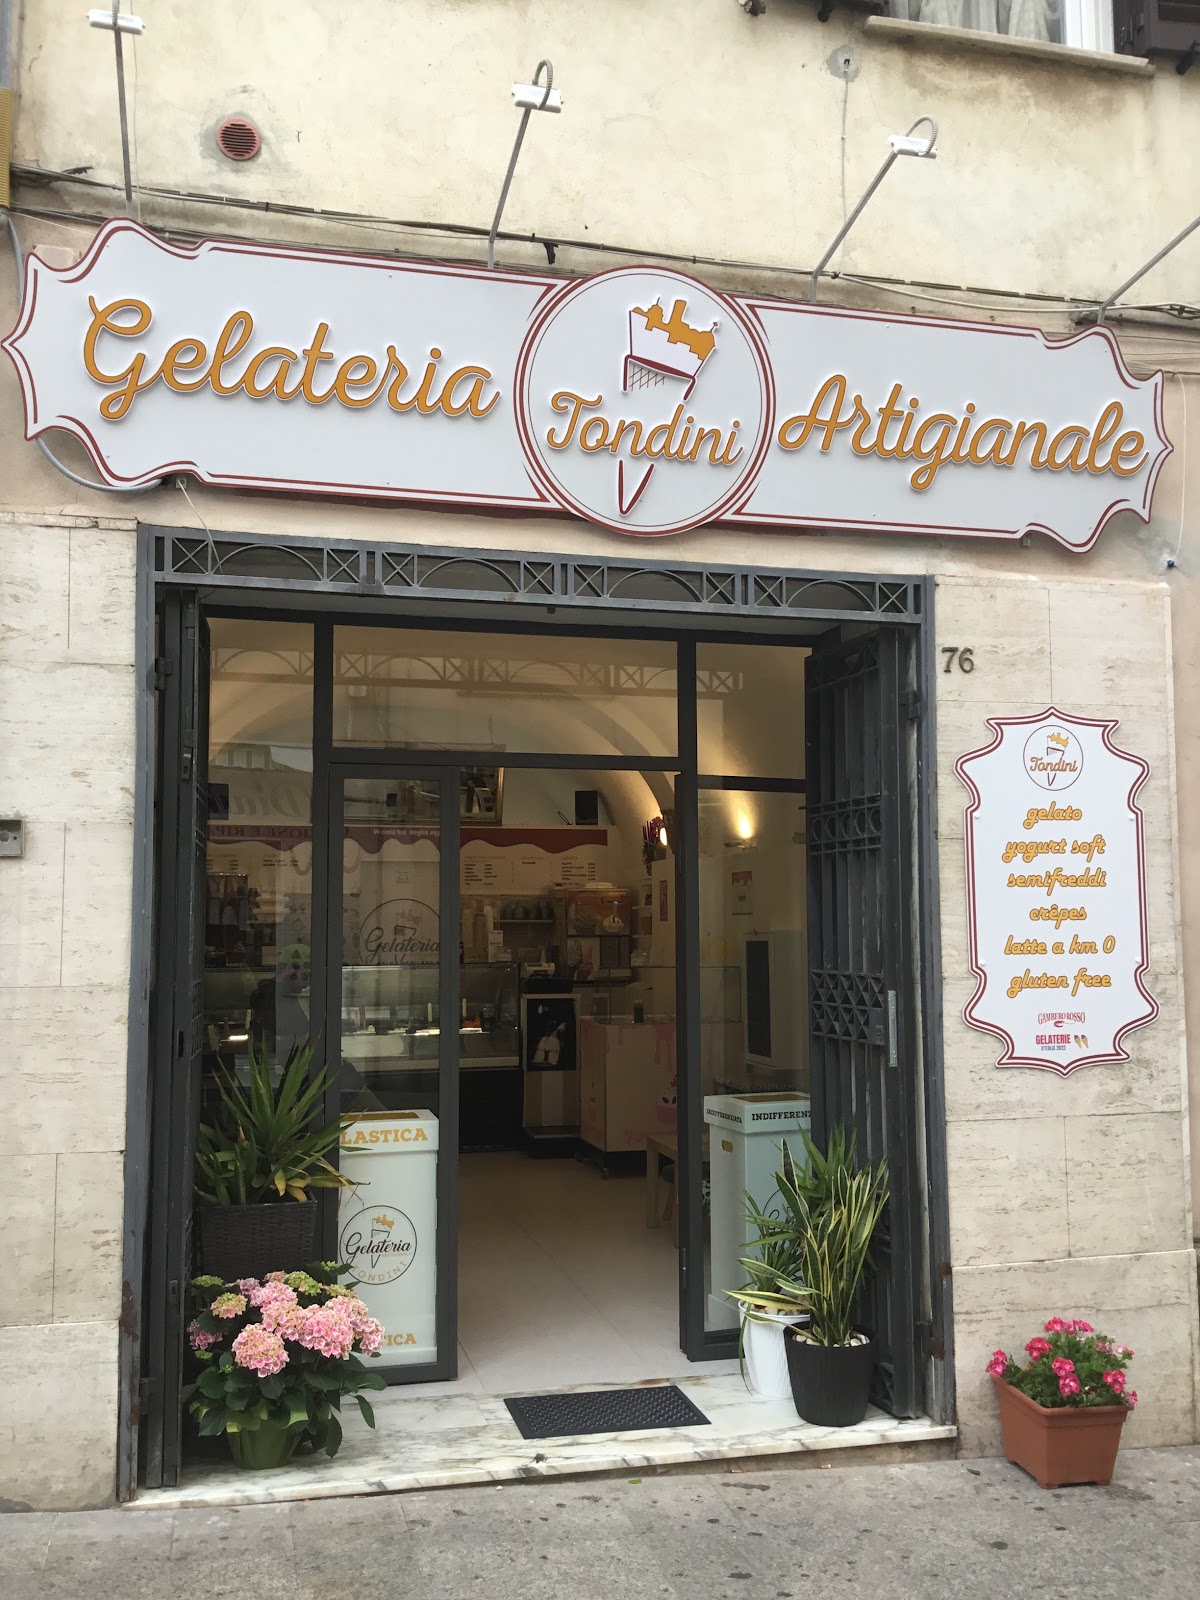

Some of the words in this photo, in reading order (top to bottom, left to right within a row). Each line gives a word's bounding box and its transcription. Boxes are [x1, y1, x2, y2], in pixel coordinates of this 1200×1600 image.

[82, 295, 500, 420] Gelateria
[546, 390, 744, 466] Tondini
[777, 373, 1149, 492] Artigianale
[942, 646, 975, 674] 76
[1030, 756, 1078, 773] Tondini
[1023, 801, 1083, 829] gelato
[1002, 838, 1067, 864] yogurt
[1071, 833, 1106, 863] soft
[1007, 867, 1107, 896] semifreddi
[1029, 904, 1087, 929] crêpes
[365, 926, 440, 963] Gelateria
[1004, 935, 1048, 955] latte
[1052, 941, 1065, 955] a
[1069, 934, 1098, 954] km
[1102, 935, 1116, 954] 0
[1007, 969, 1069, 999] gluten
[1071, 968, 1112, 996] free
[1037, 1012, 1066, 1025] GAMBERO
[1066, 1012, 1086, 1024] ROSSO
[1035, 1034, 1071, 1045] GELATERIE
[343, 1232, 412, 1266] Gelateria
[353, 1261, 406, 1281] TONDINI
